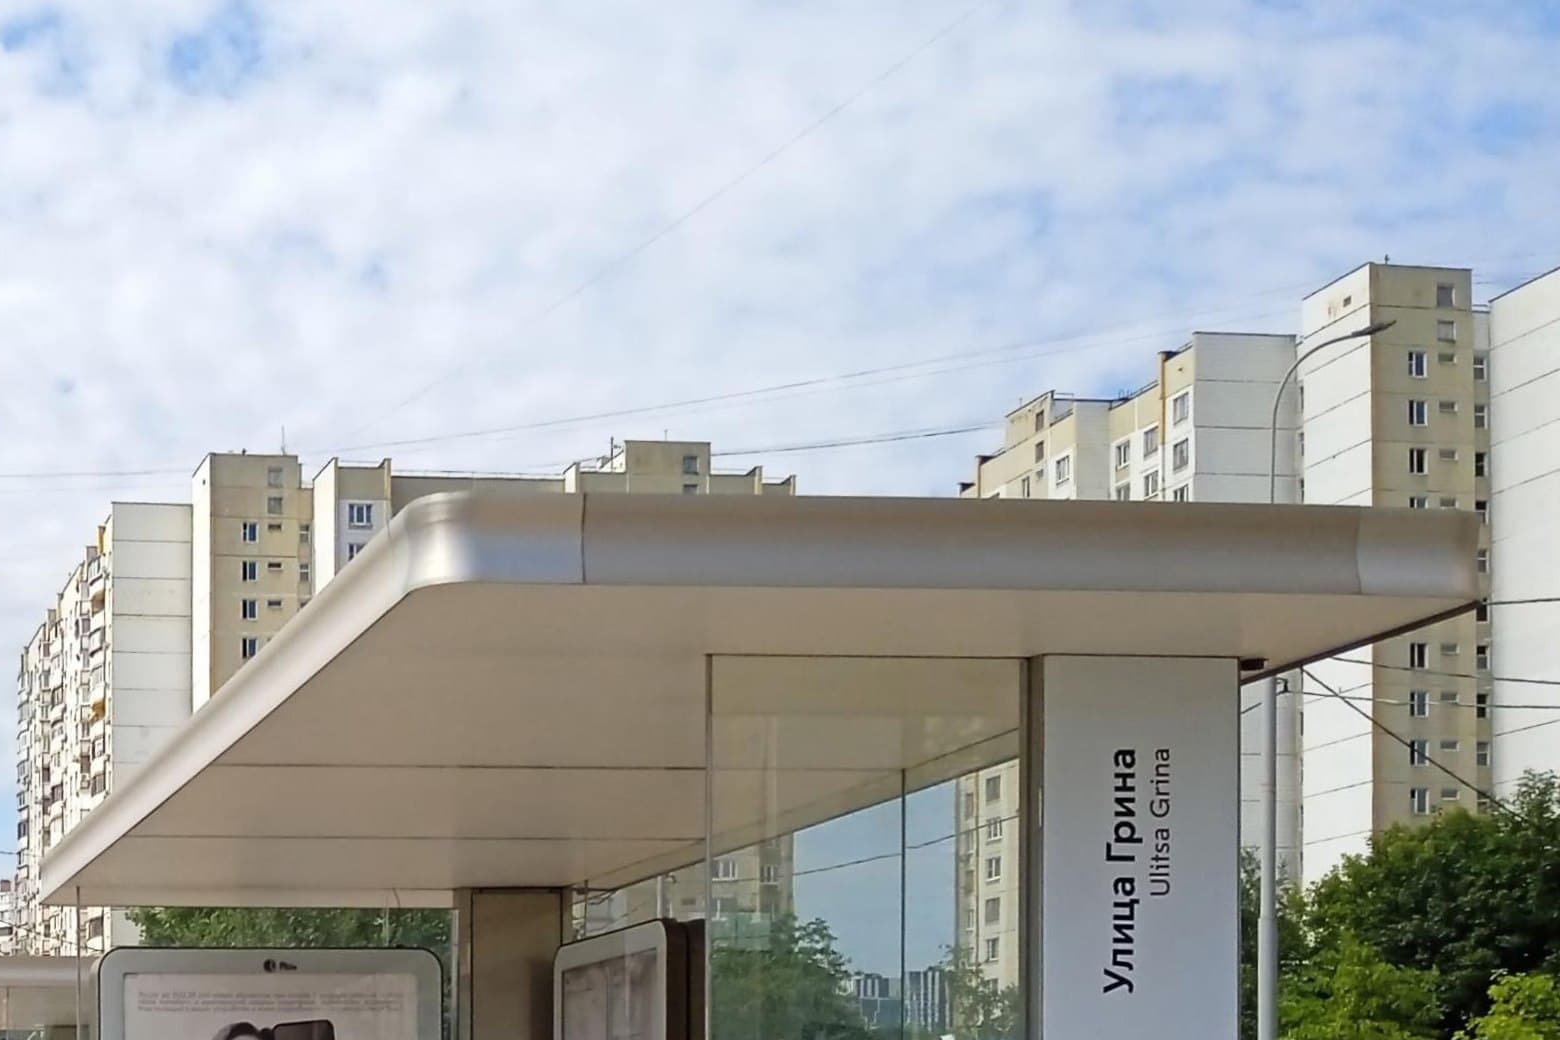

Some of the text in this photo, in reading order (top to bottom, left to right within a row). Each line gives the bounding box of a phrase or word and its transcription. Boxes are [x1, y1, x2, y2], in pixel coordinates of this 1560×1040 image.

[1103, 749, 1143, 993] Улица Грина
[1150, 748, 1170, 896] Ulitsa Grina
